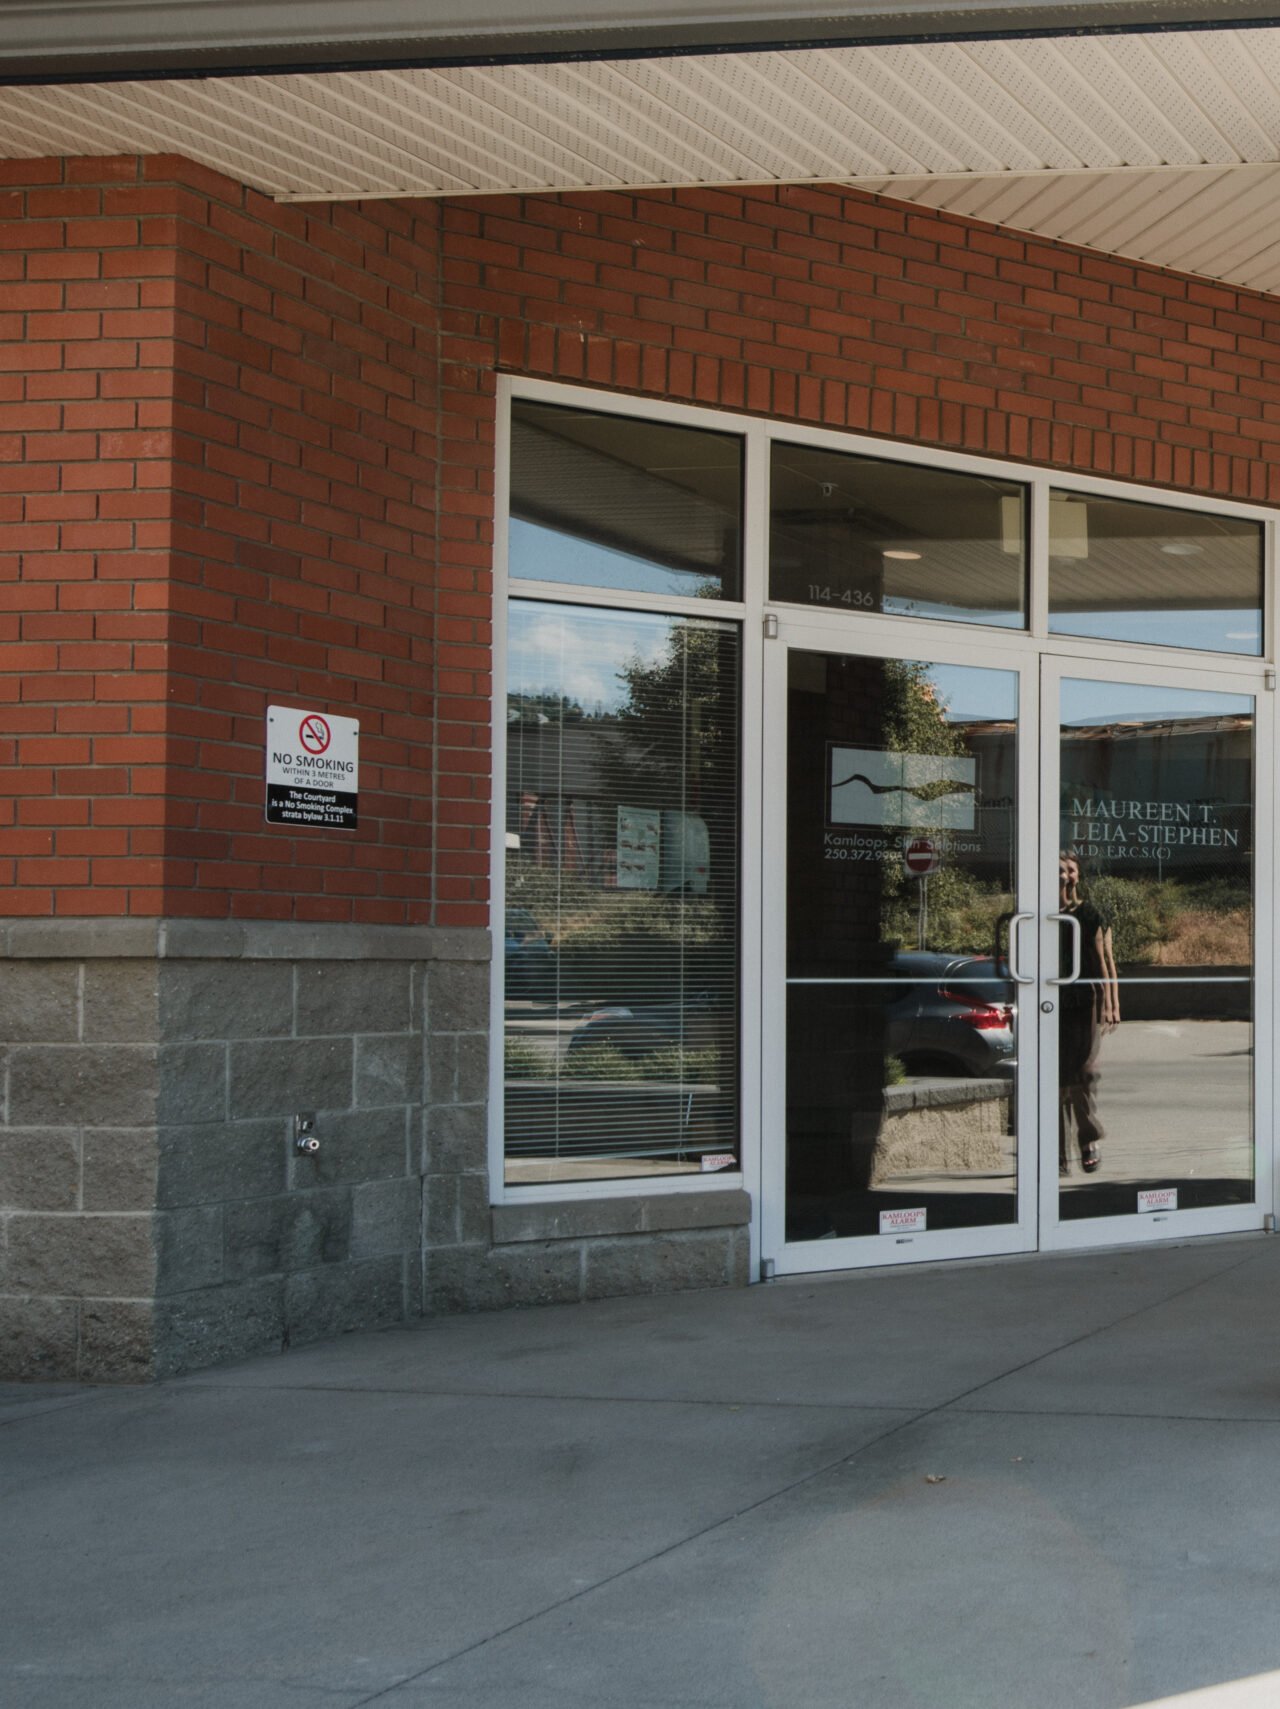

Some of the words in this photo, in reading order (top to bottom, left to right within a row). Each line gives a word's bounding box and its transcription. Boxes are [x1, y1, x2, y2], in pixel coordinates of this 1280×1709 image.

[808, 584, 874, 607] 114-436
[273, 752, 292, 765] NO
[295, 755, 354, 773] SMOKING
[282, 767, 310, 777] WITHIN
[317, 771, 346, 781] METRES
[312, 780, 334, 788] DOOR
[289, 791, 302, 799] The
[303, 792, 336, 803] Courtyard
[271, 798, 278, 807] is
[285, 800, 296, 808] No
[296, 801, 325, 813] Smoking
[325, 804, 354, 814] Complex
[1072, 798, 1191, 822] MAUREEN
[1199, 805, 1217, 824] T.
[281, 811, 302, 819] strata
[303, 812, 323, 822] bylaw
[324, 813, 344, 823] 3.1.11
[823, 833, 888, 849] Kamloops
[1072, 821, 1239, 847] LEIA-STEPHEN
[882, 1210, 925, 1220] KAMLOOPS
[890, 1217, 917, 1225] ALARM
